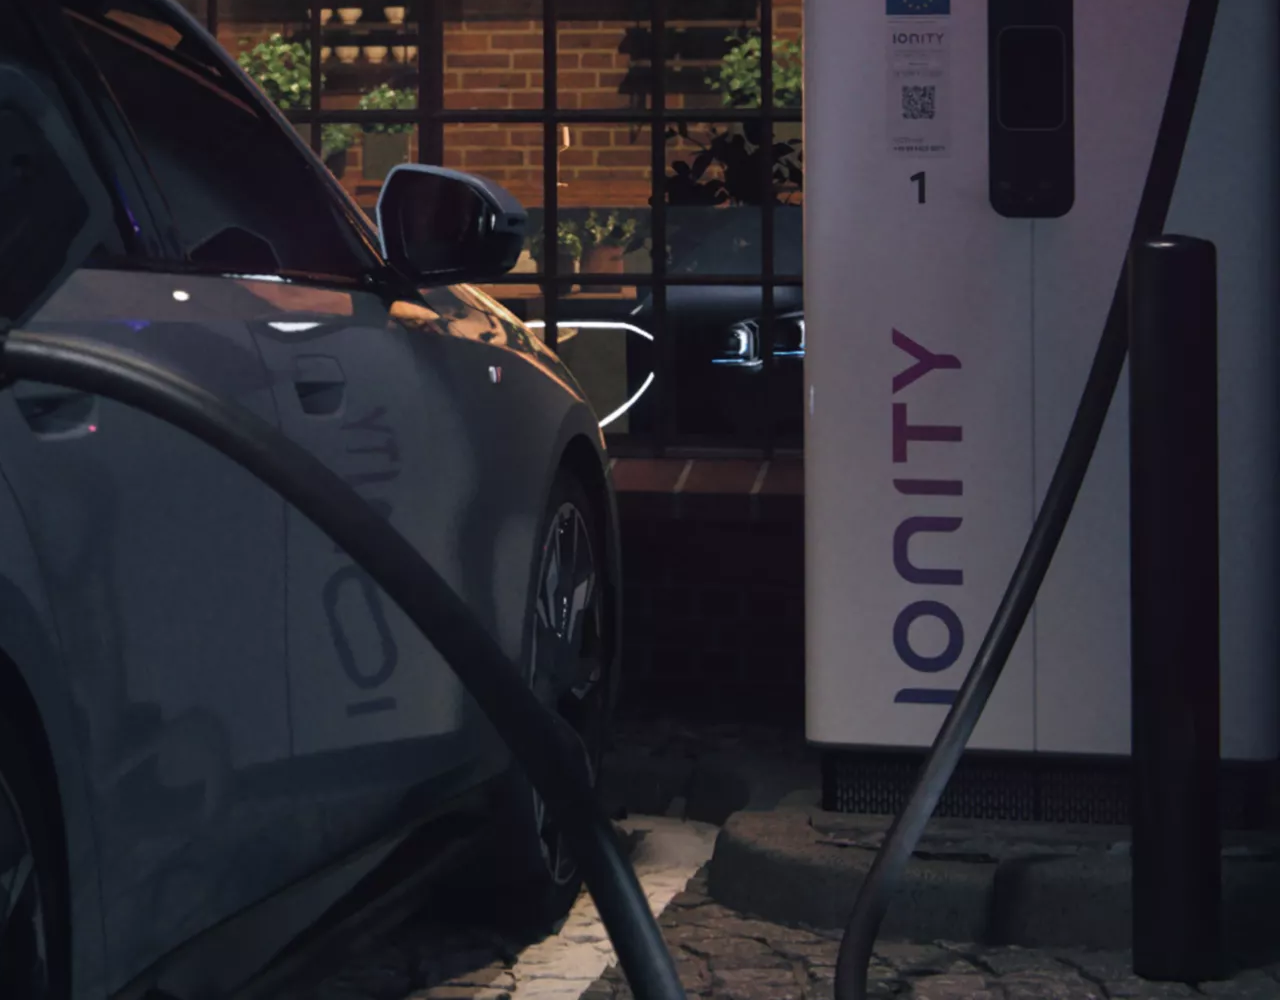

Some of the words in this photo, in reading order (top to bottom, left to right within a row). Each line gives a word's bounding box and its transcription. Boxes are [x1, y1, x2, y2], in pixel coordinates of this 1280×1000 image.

[892, 32, 945, 45] IONITY
[910, 171, 926, 204] 1
[891, 327, 965, 705] IONITY
